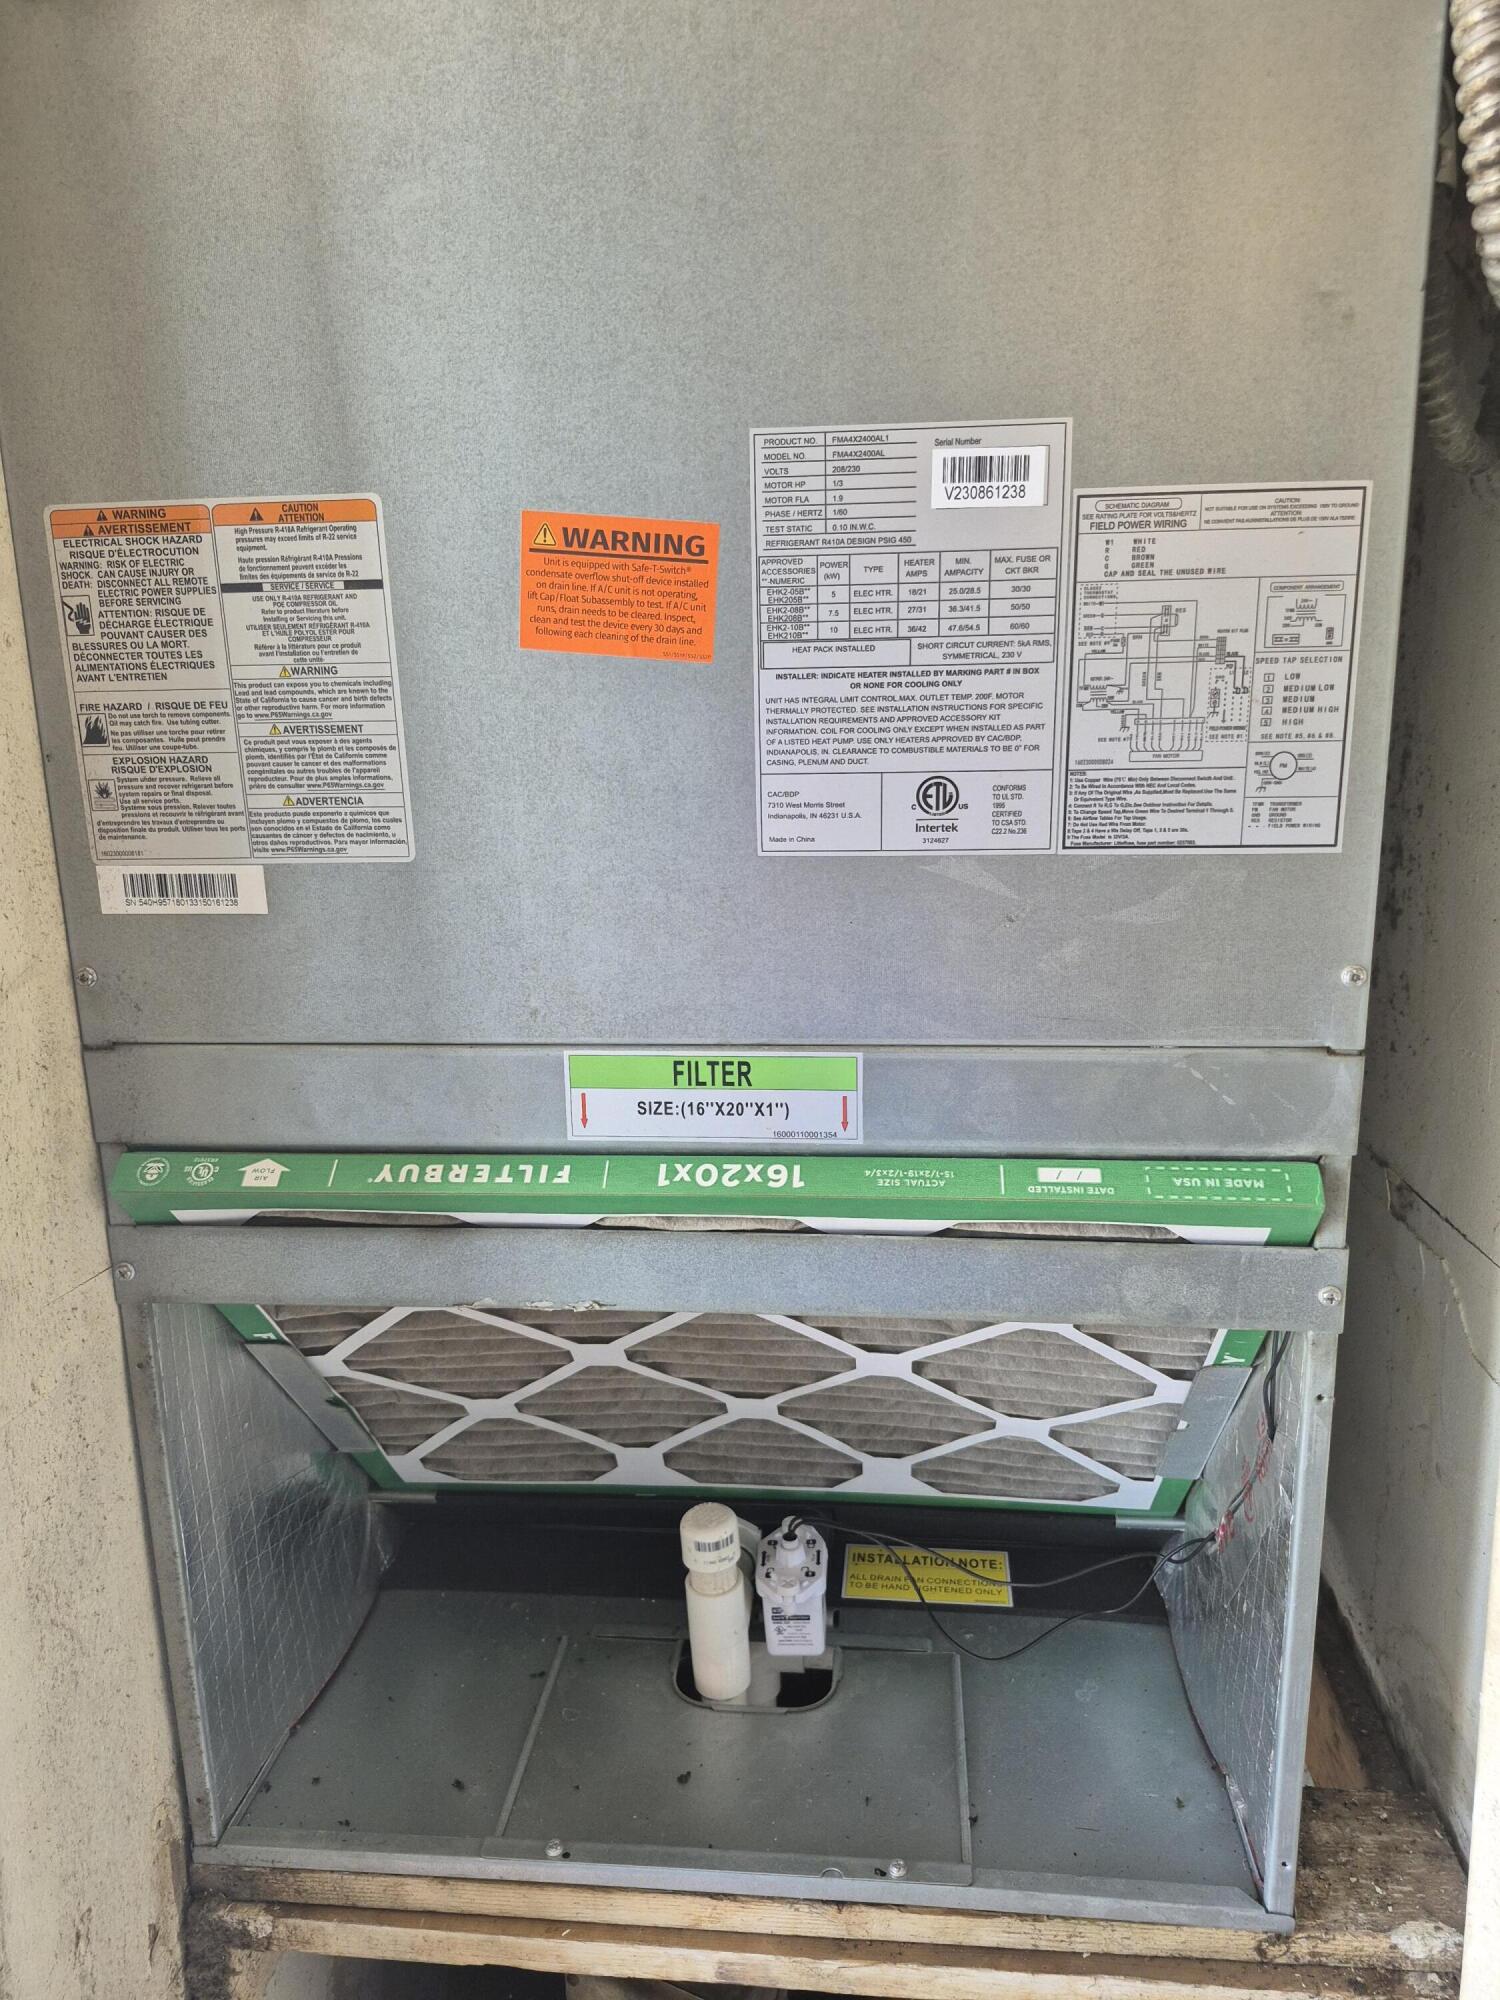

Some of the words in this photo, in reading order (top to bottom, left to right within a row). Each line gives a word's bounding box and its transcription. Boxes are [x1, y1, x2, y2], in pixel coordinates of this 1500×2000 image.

[763, 437, 801, 446] PRODUCT
[803, 436, 818, 444] NO.
[831, 434, 888, 443] FMA4X2400AL1
[934, 437, 953, 446] Serial
[954, 436, 982, 445] Number
[763, 452, 791, 461] MODEL
[792, 451, 806, 459] NO.
[832, 449, 885, 458] FMA4X2400AL
[763, 467, 788, 475] VOLTS
[831, 464, 860, 473] 208/230
[764, 481, 792, 489] MOTOR
[794, 480, 806, 488] HP
[832, 479, 843, 487] 1/3
[944, 484, 1025, 500] V230861238
[764, 496, 793, 504] MOTOR
[794, 495, 809, 503] FLA
[832, 494, 843, 502] 1.9
[281, 502, 318, 512] CAUTION
[1104, 501, 1139, 509] SCHEMATIC
[1140, 500, 1169, 508] DIAGRAM
[111, 508, 166, 520] WARNING
[764, 510, 790, 518] PHASE
[796, 509, 822, 517] HERTZ
[832, 508, 847, 516] 1/60
[278, 512, 324, 524] ATTENTION
[97, 521, 190, 535] AVERTISSEMENT
[765, 525, 784, 533] TEST
[786, 524, 812, 532] STATIC
[831, 523, 847, 531] 0.10
[1089, 521, 1115, 530] FIELD
[1117, 519, 1151, 530] POWER
[1153, 518, 1187, 528] WIRING
[62, 537, 123, 548] ELECTRICAL
[124, 536, 159, 546] SHOCK
[161, 534, 202, 544] HAZARD
[562, 526, 704, 557] WARNING
[765, 538, 819, 547] REFRIGERANT
[821, 537, 845, 545] R410A
[846, 536, 876, 545] DESIGN
[877, 536, 896, 544] PSIG
[897, 535, 912, 543] 450
[68, 549, 105, 560] RISQUE
[107, 546, 199, 558] D'ÉLECTROCUTION
[58, 560, 102, 570] WARNING:
[106, 559, 126, 568] RISK
[128, 559, 140, 568] OF
[142, 557, 184, 568] ELECTRIC
[543, 555, 560, 566] Unit
[570, 558, 610, 571] equipped
[611, 560, 629, 571] with
[60, 570, 92, 580] SHOCK.
[97, 569, 115, 578] CAN
[117, 568, 147, 578] CAUSE
[148, 567, 178, 577] INJURY
[181, 567, 194, 576] OR
[525, 567, 572, 579] condensate
[574, 570, 610, 581] overflow
[611, 572, 644, 584] shut-off
[645, 574, 672, 586] device
[673, 577, 709, 588] installed
[61, 579, 92, 589] DEATH:
[96, 578, 150, 588] DISCONNECT
[154, 577, 170, 586] ALL
[172, 576, 208, 586] REMOTE
[270, 581, 299, 591] SERVICE
[305, 580, 334, 590] SERVICE
[97, 587, 139, 598] ELECTRIC
[141, 586, 173, 596] POWER
[174, 585, 218, 596] SUPPLIES
[535, 581, 546, 589] on
[548, 579, 569, 590] drain
[571, 581, 588, 592] line.
[590, 583, 595, 592] If
[597, 583, 612, 594] A/C
[614, 584, 630, 595] unit
[632, 587, 639, 596] is
[641, 587, 654, 596] not
[656, 587, 698, 602] operating,
[98, 597, 133, 607] BEFORE
[135, 596, 181, 606] SERVICING
[535, 625, 572, 639] following
[573, 628, 593, 639] each
[594, 630, 629, 643] cleaning
[630, 632, 638, 642] of
[640, 633, 654, 643] the
[655, 634, 676, 645] drain
[678, 636, 696, 646] line.
[289, 665, 337, 676] WARNING
[79, 703, 100, 712] FIRE
[102, 702, 142, 711] HAZARD
[154, 701, 191, 710] RISQUE
[193, 700, 206, 709] DE
[208, 700, 227, 709] FEU
[282, 724, 362, 734] AVERTISSEMENT
[112, 755, 166, 765] EXPLOSION
[168, 755, 208, 764] HAZARD
[111, 765, 146, 774] RISQUE
[148, 764, 212, 773] D'EXPLOSION
[295, 796, 364, 806] ADVERTENCIA
[922, 782, 953, 811] ETL
[767, 812, 808, 820] Indianapolis,
[818, 811, 838, 819] 46231
[915, 822, 958, 832] Intertek
[124, 898, 136, 906] SN
[673, 1060, 751, 1086] FILTER
[773, 1130, 837, 1140] 16000110001354
[657, 1162, 805, 1189] 16x20x1
[877, 1178, 901, 1186] SIZE
[904, 1179, 946, 1187] ACTUAL
[1172, 1177, 1201, 1187] USA
[1206, 1178, 1219, 1188] IN
[1224, 1178, 1265, 1188] MADE
[1028, 1185, 1084, 1194] INSTALLED
[1087, 1186, 1115, 1195] DATE
[958, 1558, 1003, 1570] NOTE:
[849, 1573, 867, 1581] ALL
[975, 1588, 1003, 1596] ONLY
